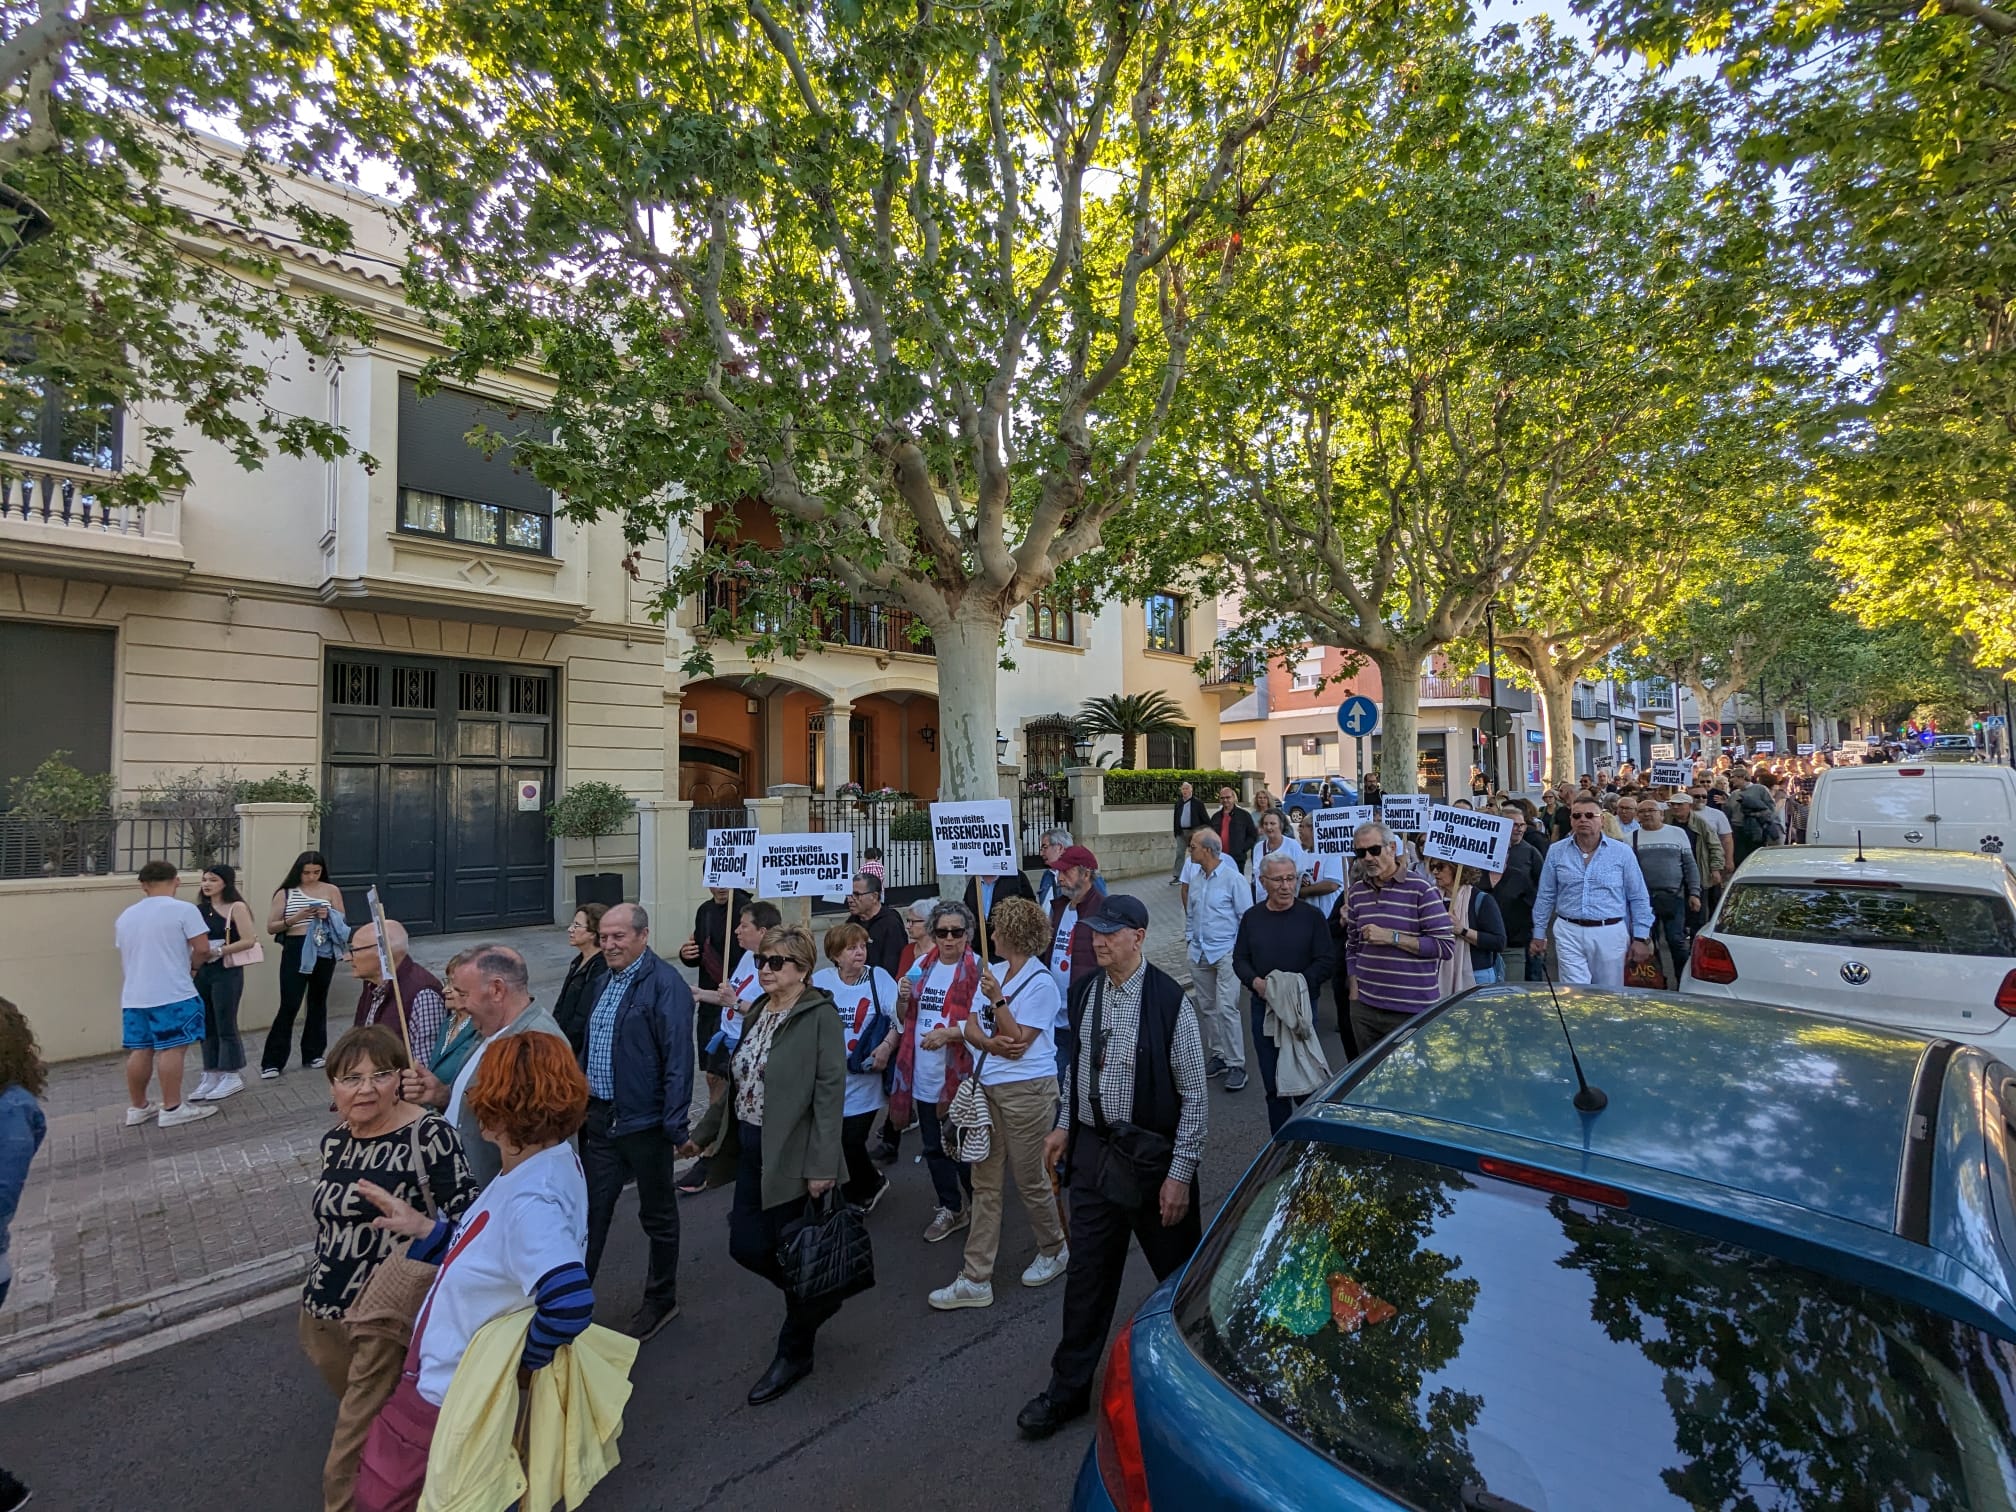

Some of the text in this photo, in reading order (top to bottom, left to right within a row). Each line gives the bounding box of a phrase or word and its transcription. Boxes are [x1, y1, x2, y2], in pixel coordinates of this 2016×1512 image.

[1316, 811, 1350, 821] defensem
[1385, 809, 1415, 818] SANITAT
[939, 815, 985, 825] Volem visites
[1432, 810, 1501, 832] potenciem
[935, 824, 1001, 840] PRESENCIALS
[1317, 825, 1354, 840] SANITAT
[1444, 823, 1455, 833] la
[713, 830, 757, 846] la SANITAT
[768, 845, 823, 854] Volem visites
[951, 841, 958, 850] al
[959, 841, 982, 849] nostre
[708, 847, 717, 856] no
[726, 847, 735, 856] un
[711, 853, 748, 877] NEGOCI!
[762, 853, 839, 868] PRESENCIALS
[780, 868, 788, 876] al
[789, 867, 816, 875] nostre
